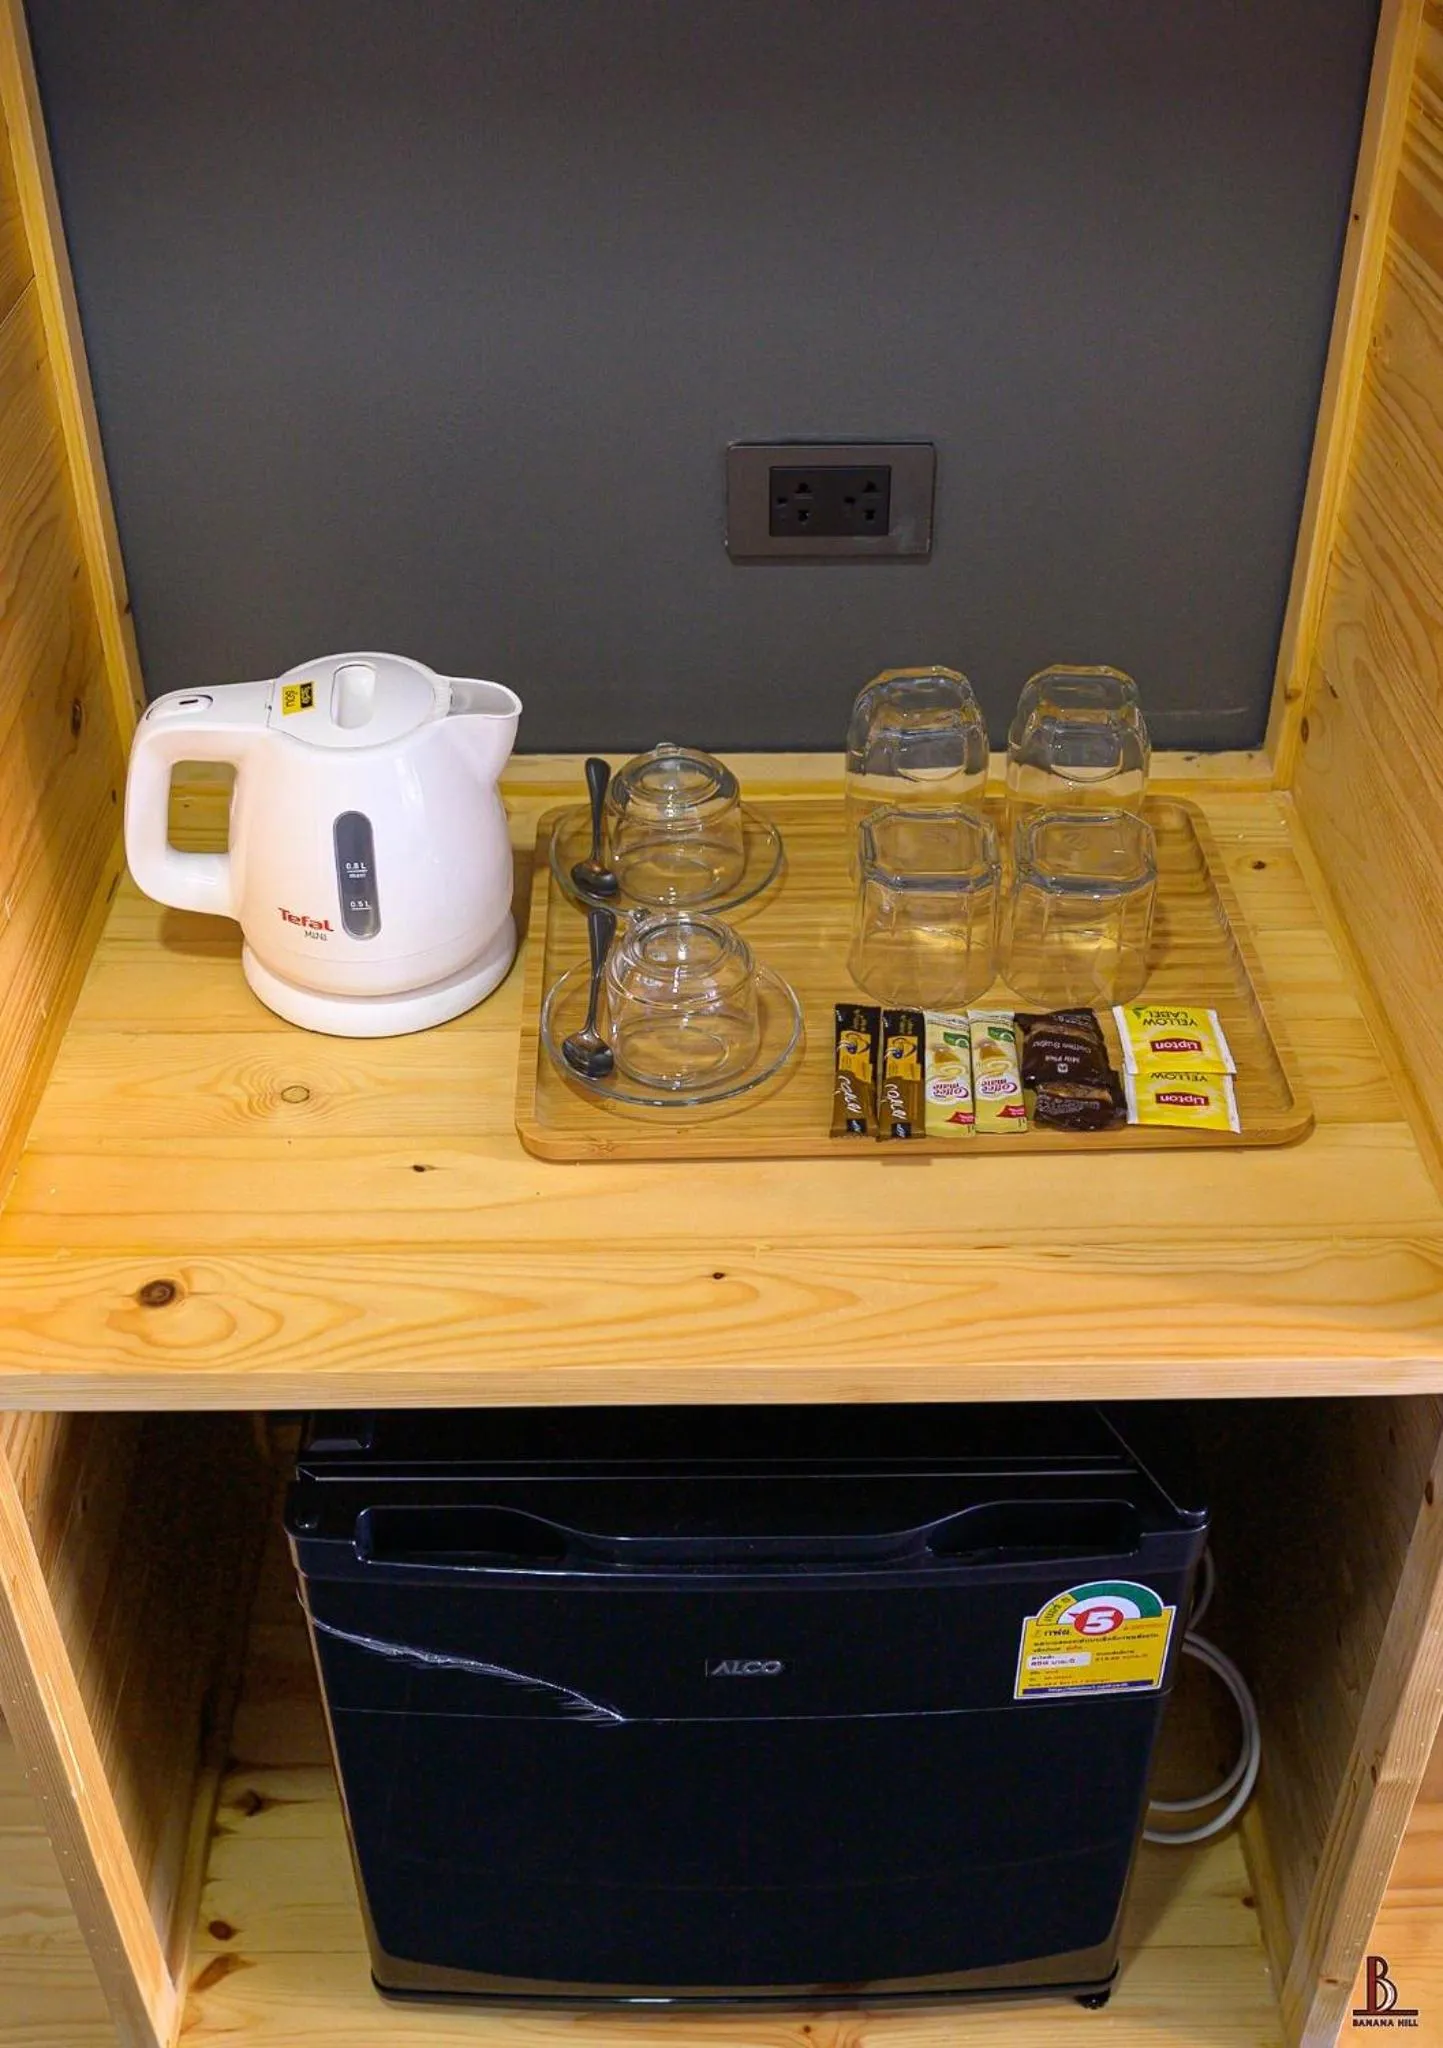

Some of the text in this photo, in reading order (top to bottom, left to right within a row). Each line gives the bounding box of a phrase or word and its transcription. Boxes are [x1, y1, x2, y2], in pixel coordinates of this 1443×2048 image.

[277, 906, 336, 933] Tefal
[1148, 1009, 1188, 1018] LABEL
[1143, 1018, 1198, 1027] YELLOW
[1155, 1039, 1198, 1051] Lipton
[1160, 1094, 1205, 1105] Lipton
[1081, 1609, 1117, 1634] 5
[711, 1660, 782, 1676] ALCO
